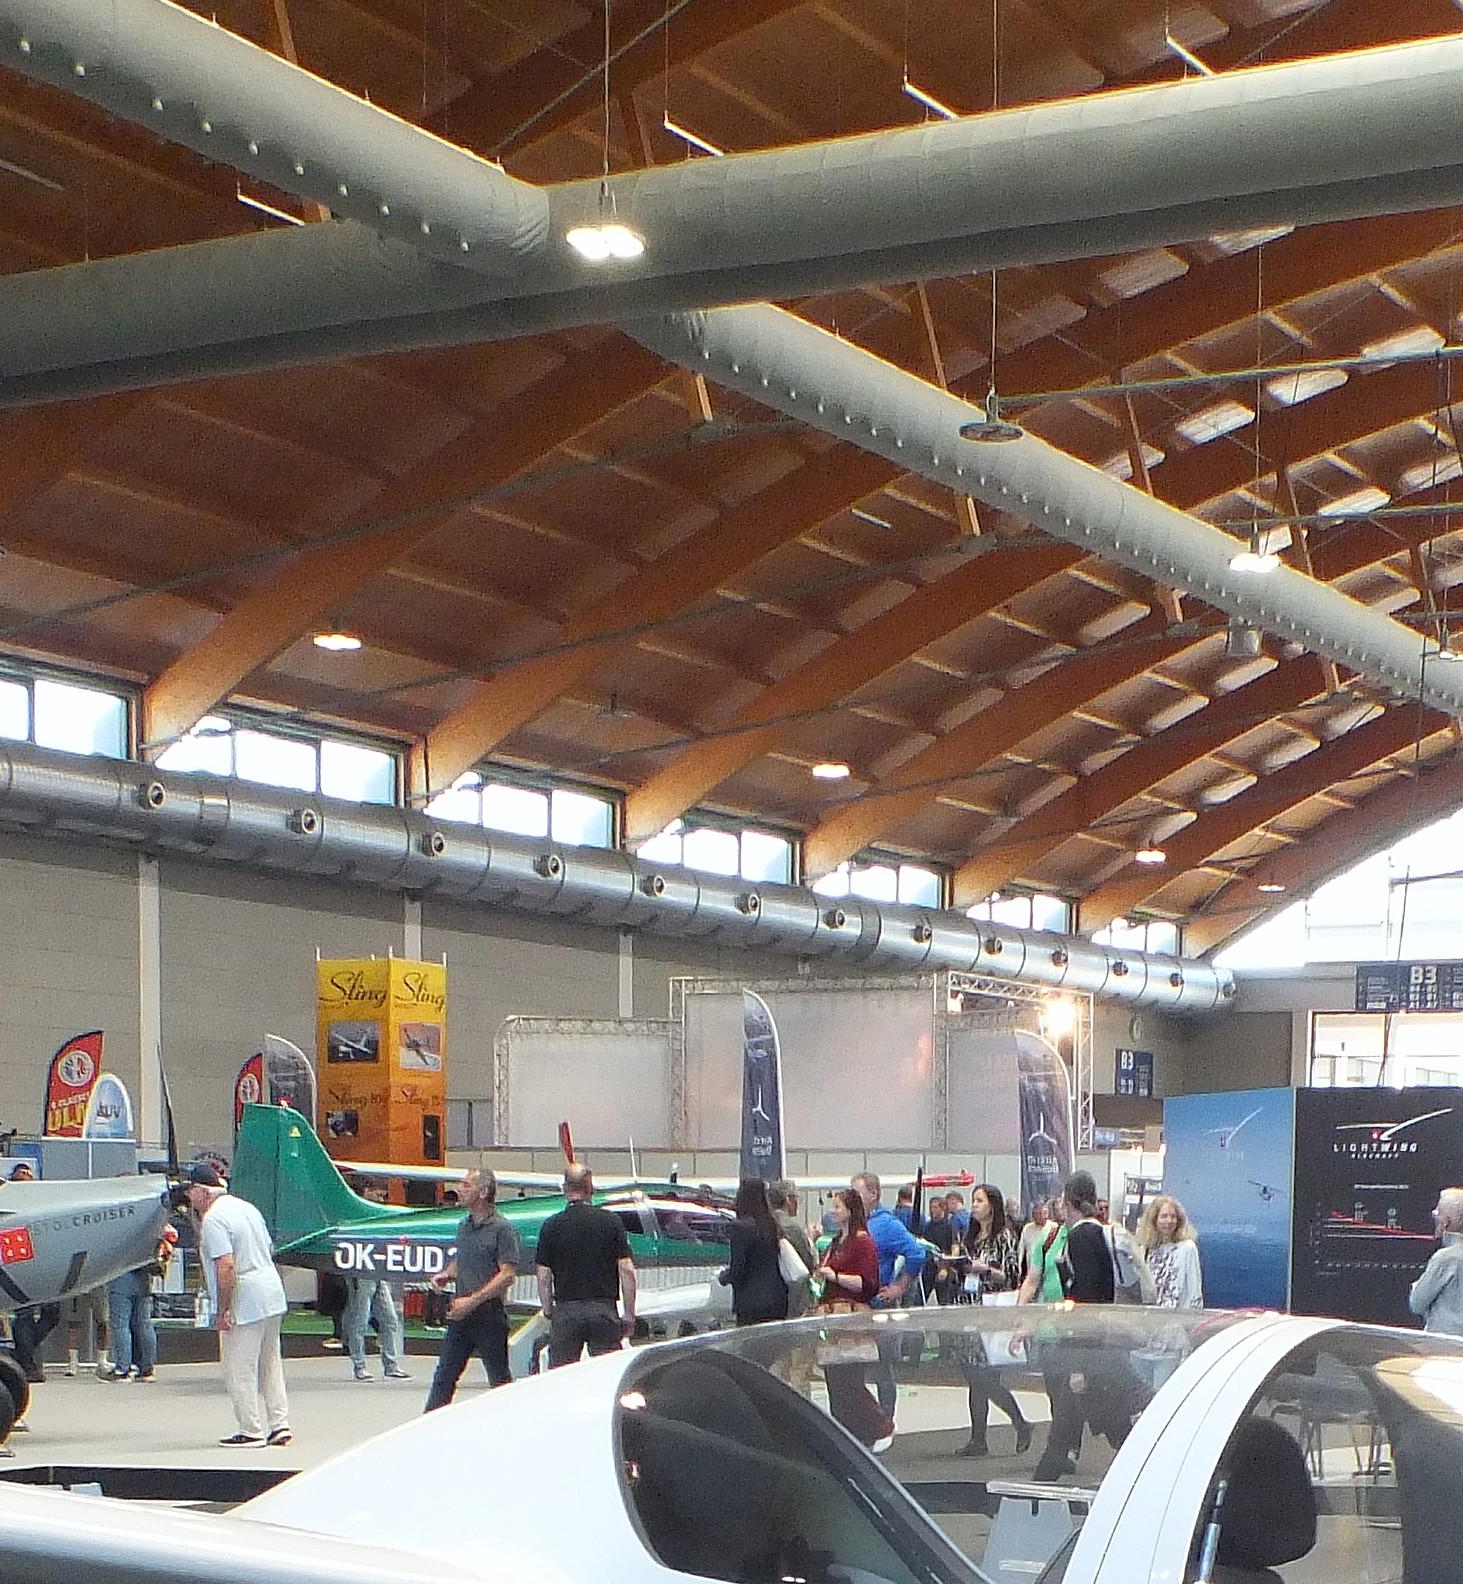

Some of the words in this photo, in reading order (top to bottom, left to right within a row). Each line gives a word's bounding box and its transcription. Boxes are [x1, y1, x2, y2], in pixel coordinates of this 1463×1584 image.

[319, 971, 387, 1008] Sling
[1410, 966, 1437, 984] B3
[393, 972, 446, 1012] Sling
[72, 1204, 136, 1228] CRUISER
